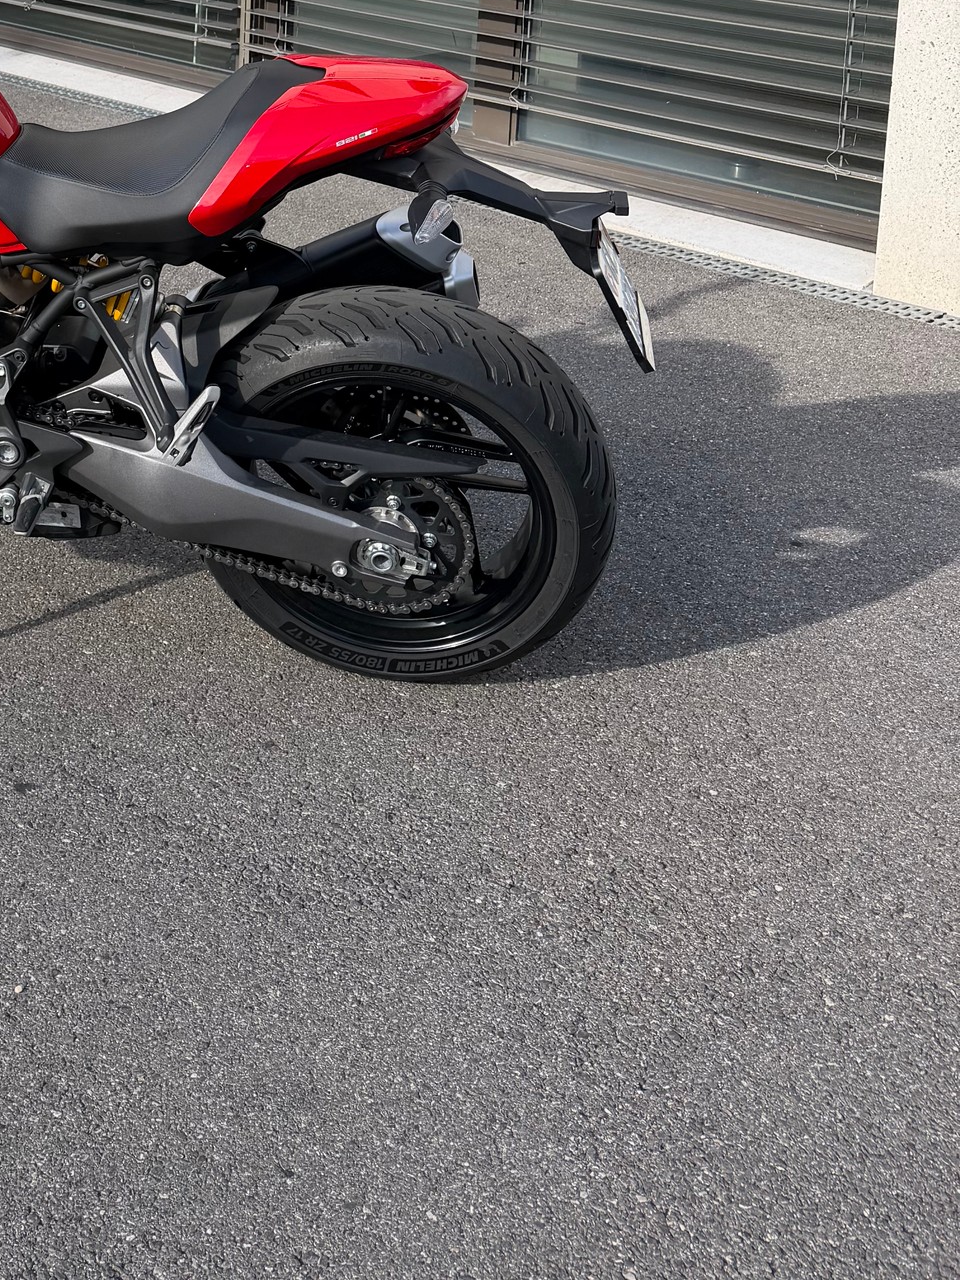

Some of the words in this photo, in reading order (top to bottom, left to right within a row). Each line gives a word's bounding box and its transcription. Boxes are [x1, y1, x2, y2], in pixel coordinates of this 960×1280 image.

[289, 363, 374, 385] MICHELIN
[386, 366, 435, 381] ROAD
[286, 627, 305, 640] 17
[304, 635, 328, 652] ZR
[328, 646, 384, 670] 180/55
[395, 649, 479, 672] MICHELIN
